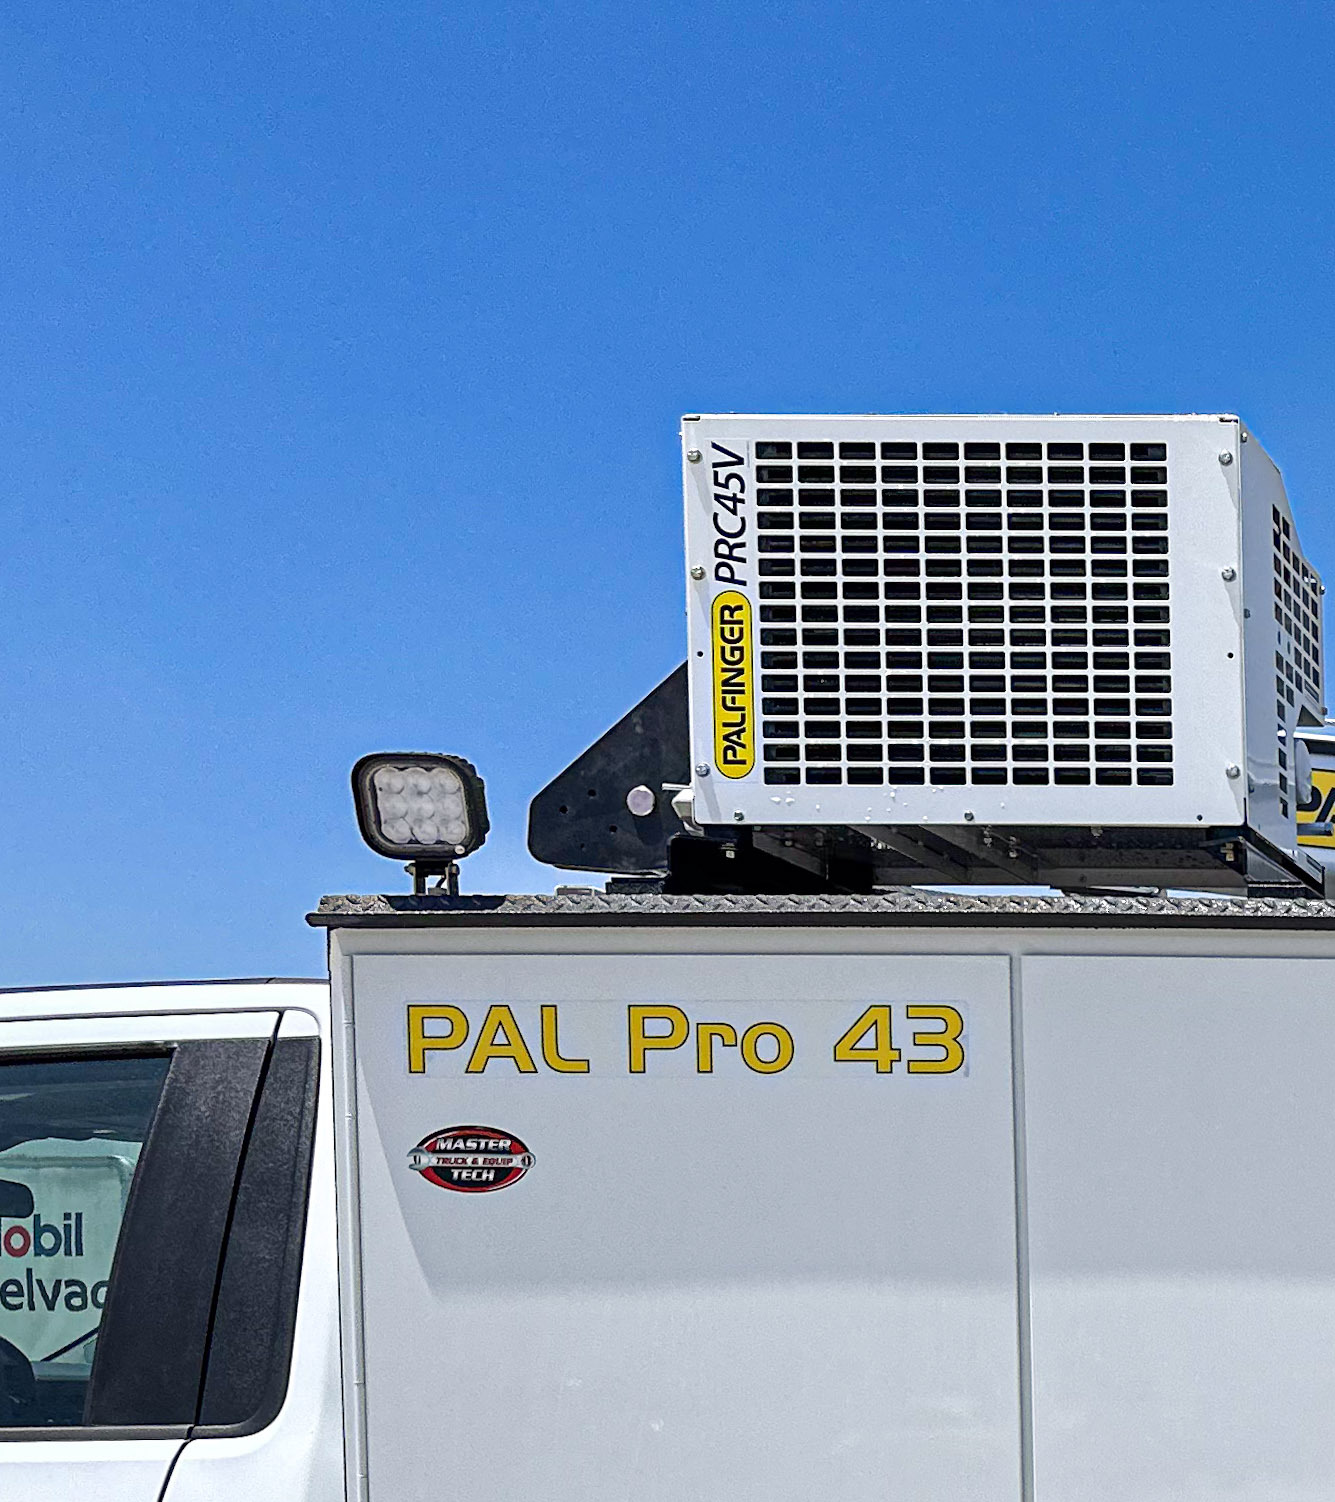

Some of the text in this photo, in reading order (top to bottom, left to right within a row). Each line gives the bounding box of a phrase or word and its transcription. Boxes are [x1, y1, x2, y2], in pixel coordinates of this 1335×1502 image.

[711, 440, 748, 587] PRC45V
[719, 603, 748, 766] PALFINGER
[406, 1004, 966, 1074] PAL Pro 43
[435, 1138, 513, 1152] MASTER
[436, 1156, 469, 1166] TRUCK
[450, 1168, 496, 1182] TECH
[0, 1212, 84, 1258] obil
